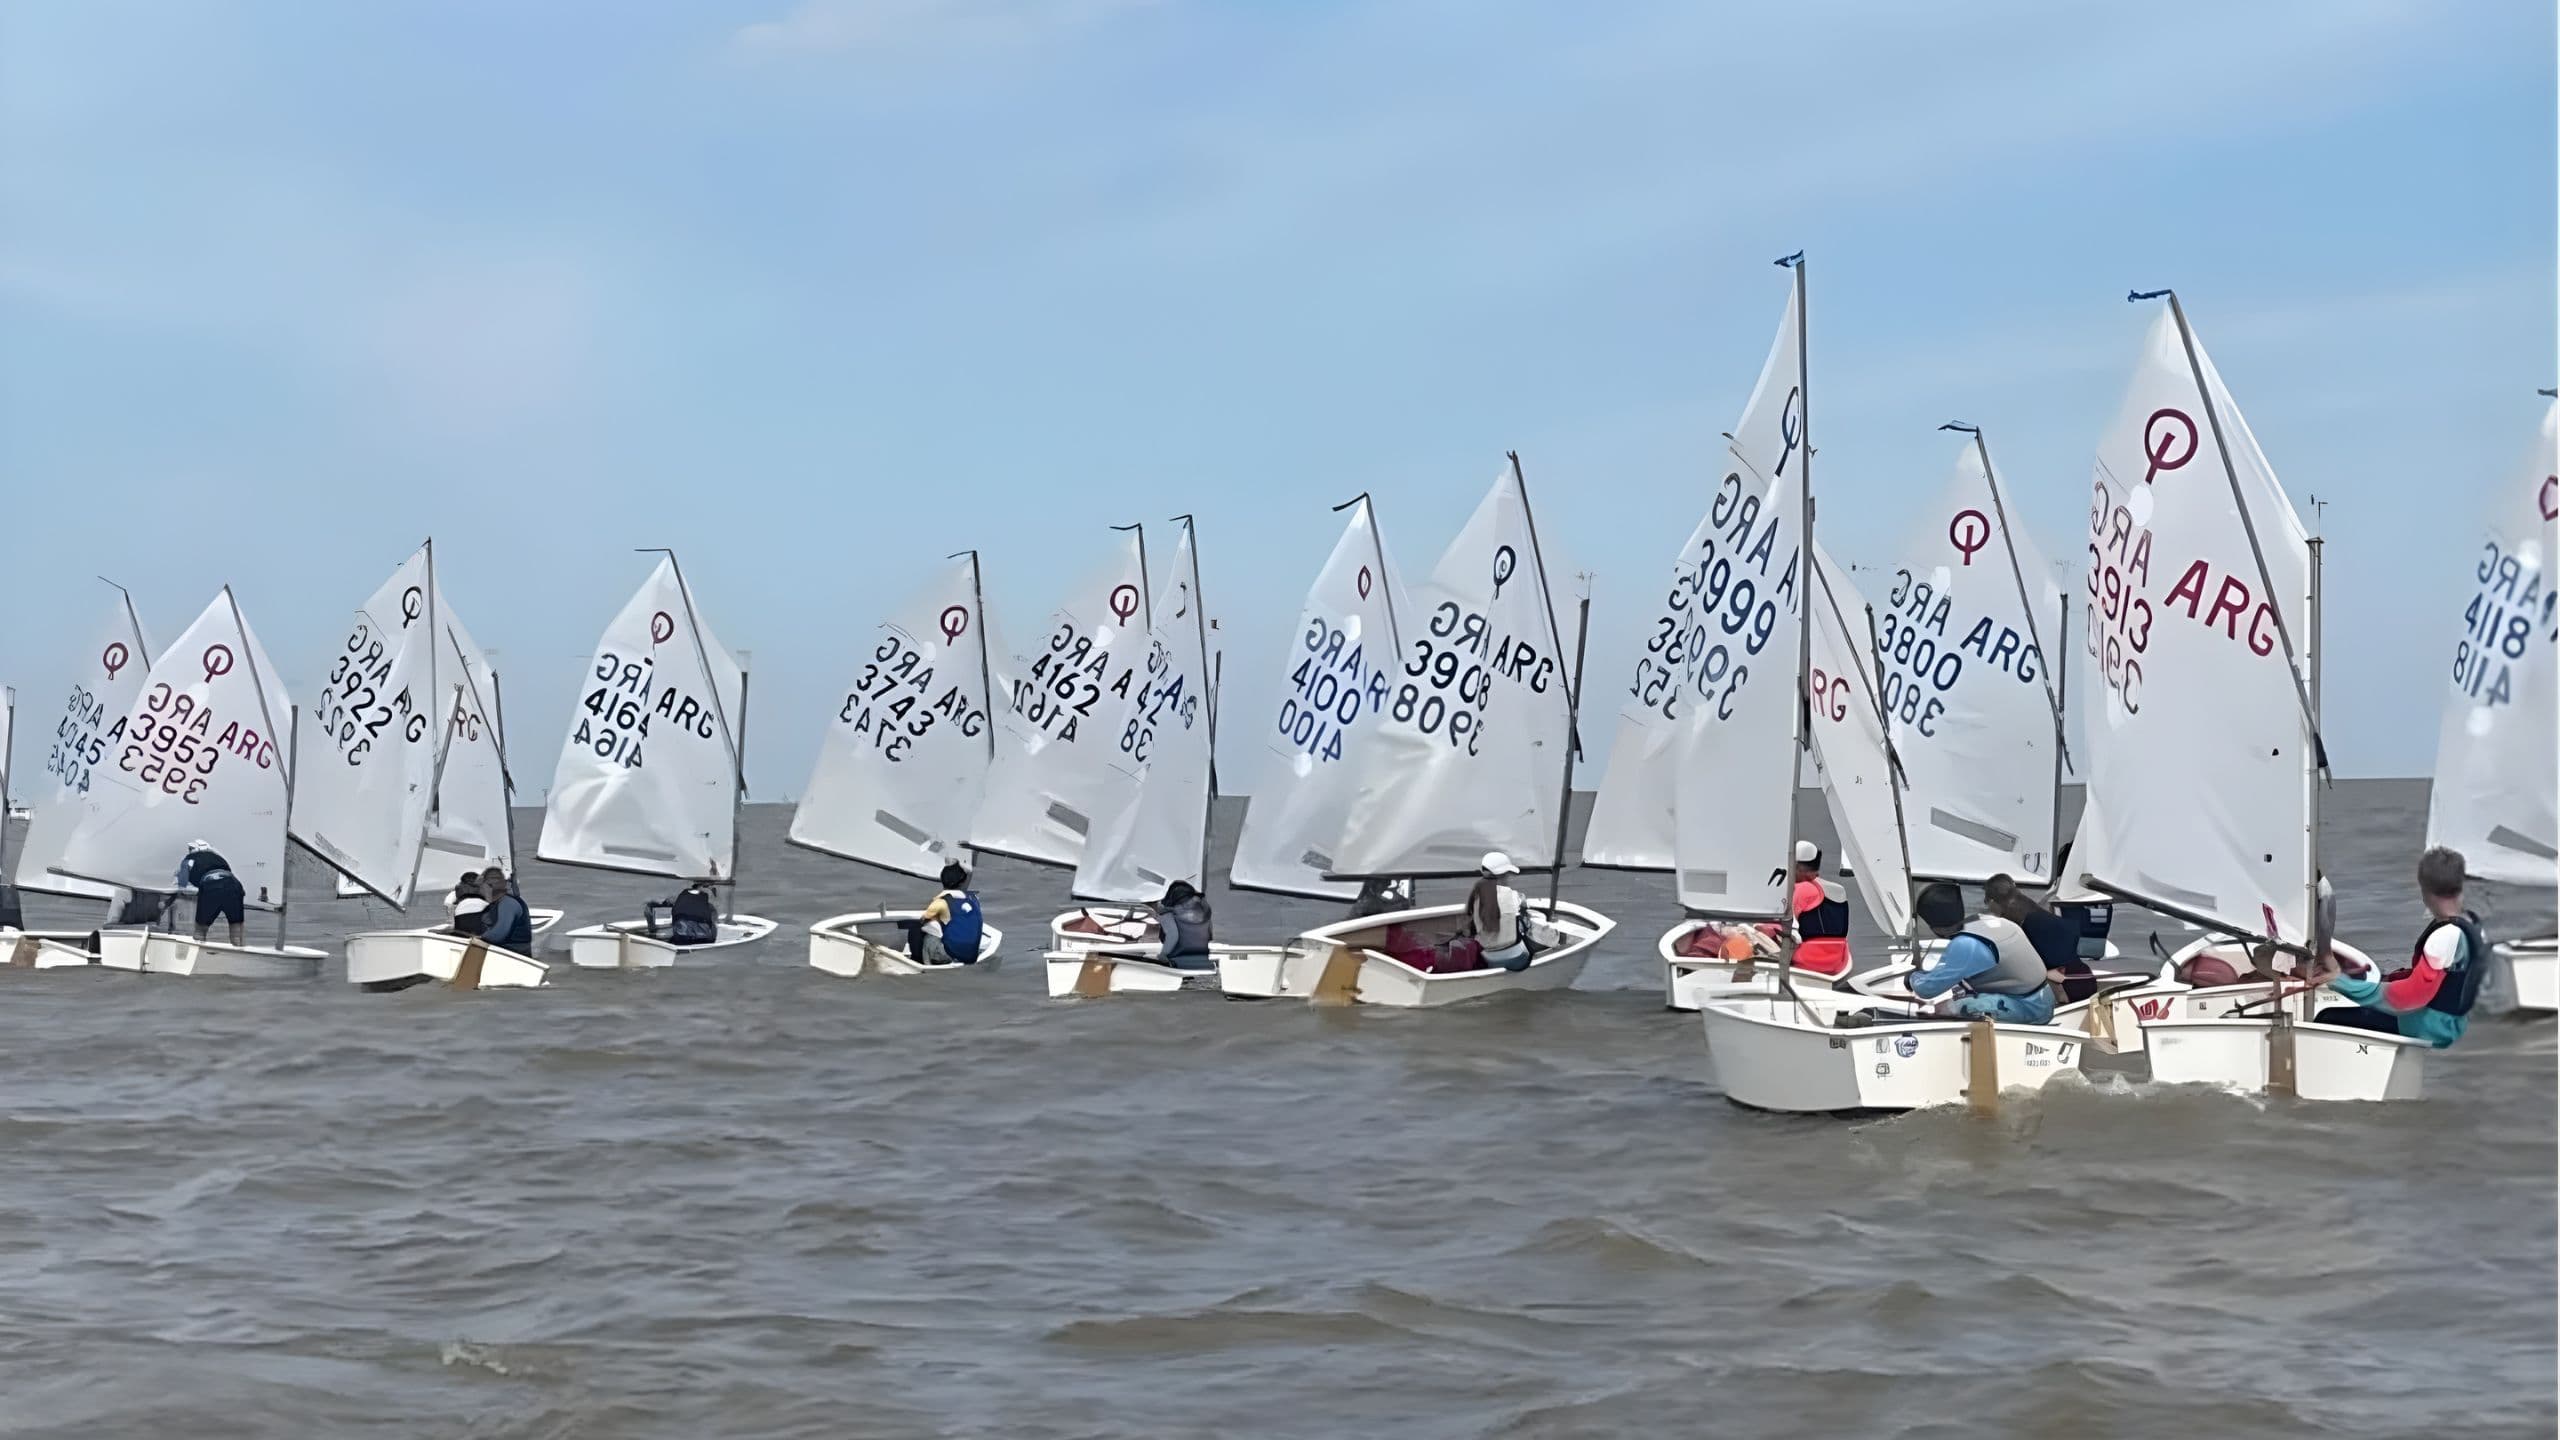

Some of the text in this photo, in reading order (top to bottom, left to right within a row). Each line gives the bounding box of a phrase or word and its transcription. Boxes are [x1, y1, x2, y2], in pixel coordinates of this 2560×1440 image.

[1692, 539, 1776, 655] 3999
[2088, 543, 2152, 653] 3913
[2164, 559, 2277, 657] ARG
[2465, 592, 2531, 659] 4118
[1405, 639, 1491, 712] 3908
[1492, 634, 1554, 693] ARG
[1879, 613, 1962, 691] 3800
[1960, 616, 2040, 683] ARG
[331, 656, 393, 739] 3922
[656, 687, 714, 739] ARG
[857, 664, 935, 736] 3743
[1032, 653, 1100, 717] 4162
[1291, 657, 1361, 725] 4100
[130, 714, 219, 774] 3953
[217, 721, 273, 769] ARG
